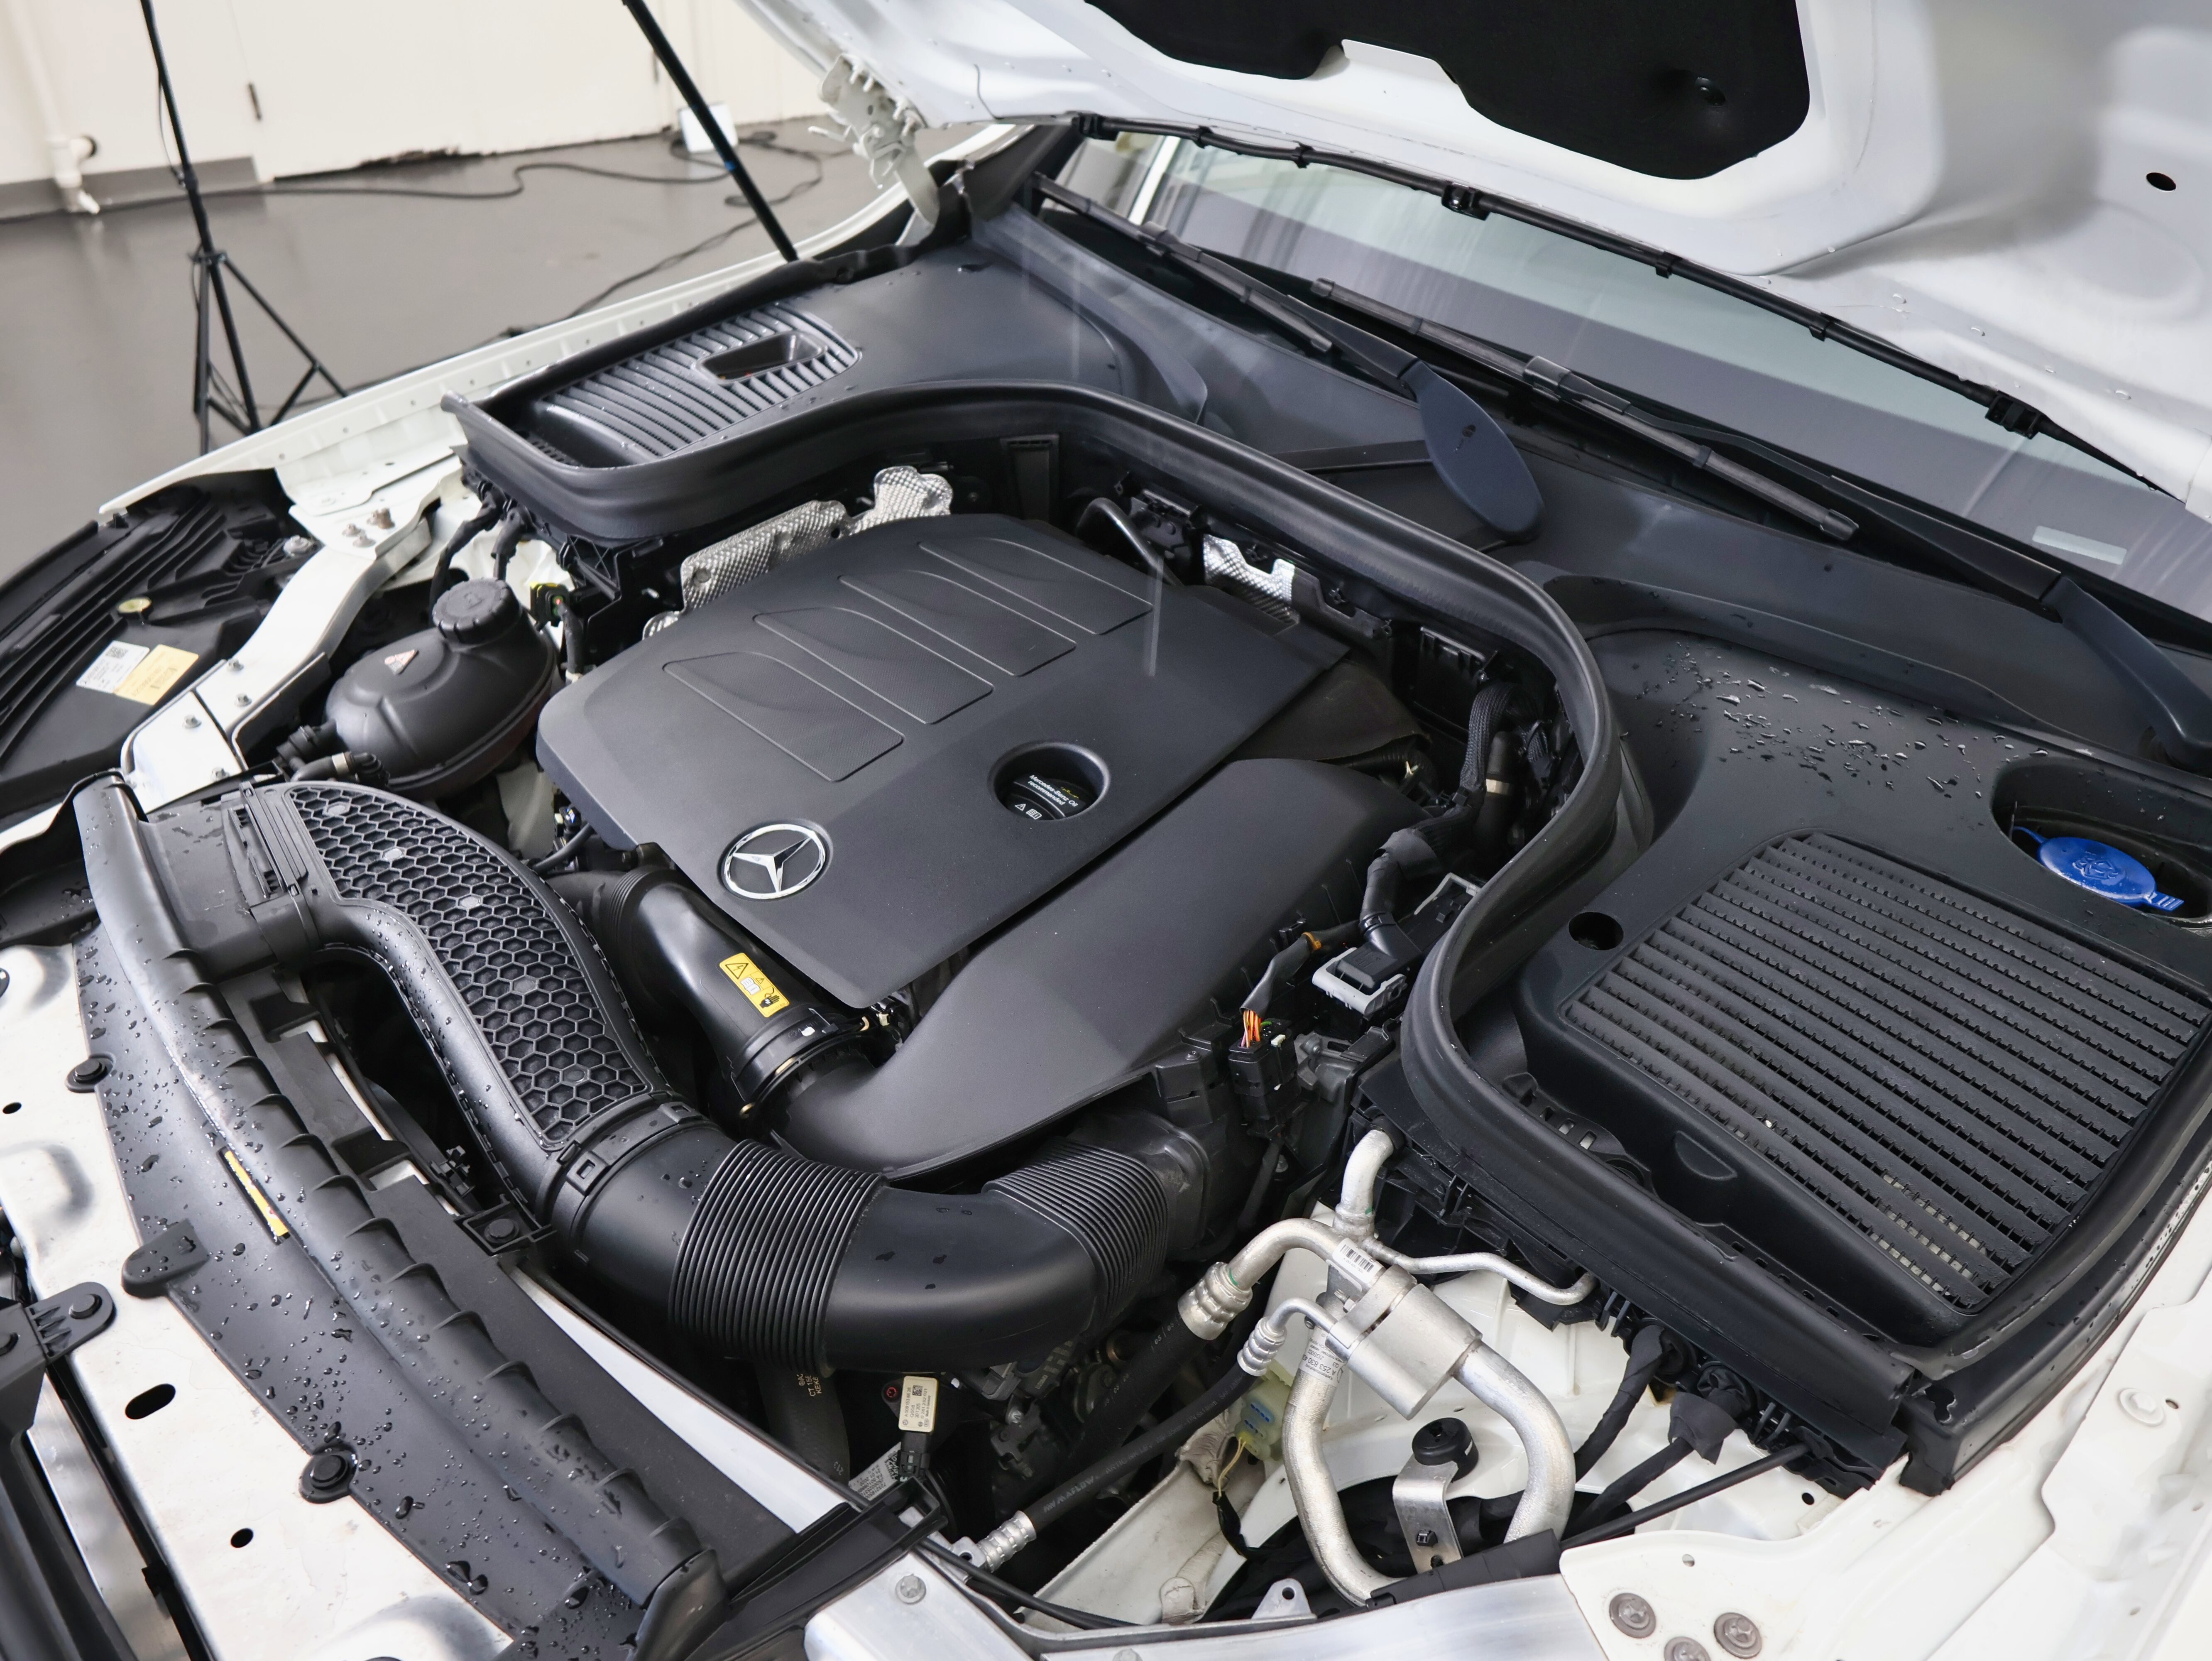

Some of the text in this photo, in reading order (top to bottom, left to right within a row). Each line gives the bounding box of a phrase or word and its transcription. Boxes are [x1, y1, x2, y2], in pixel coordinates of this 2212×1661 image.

[1029, 775, 1069, 801] Mercedes-Benz
[1028, 781, 1066, 805] recommended
[1308, 1358, 1319, 1367] 830
[1319, 1364, 1331, 1373] 253
[808, 1388, 816, 1397] CT
